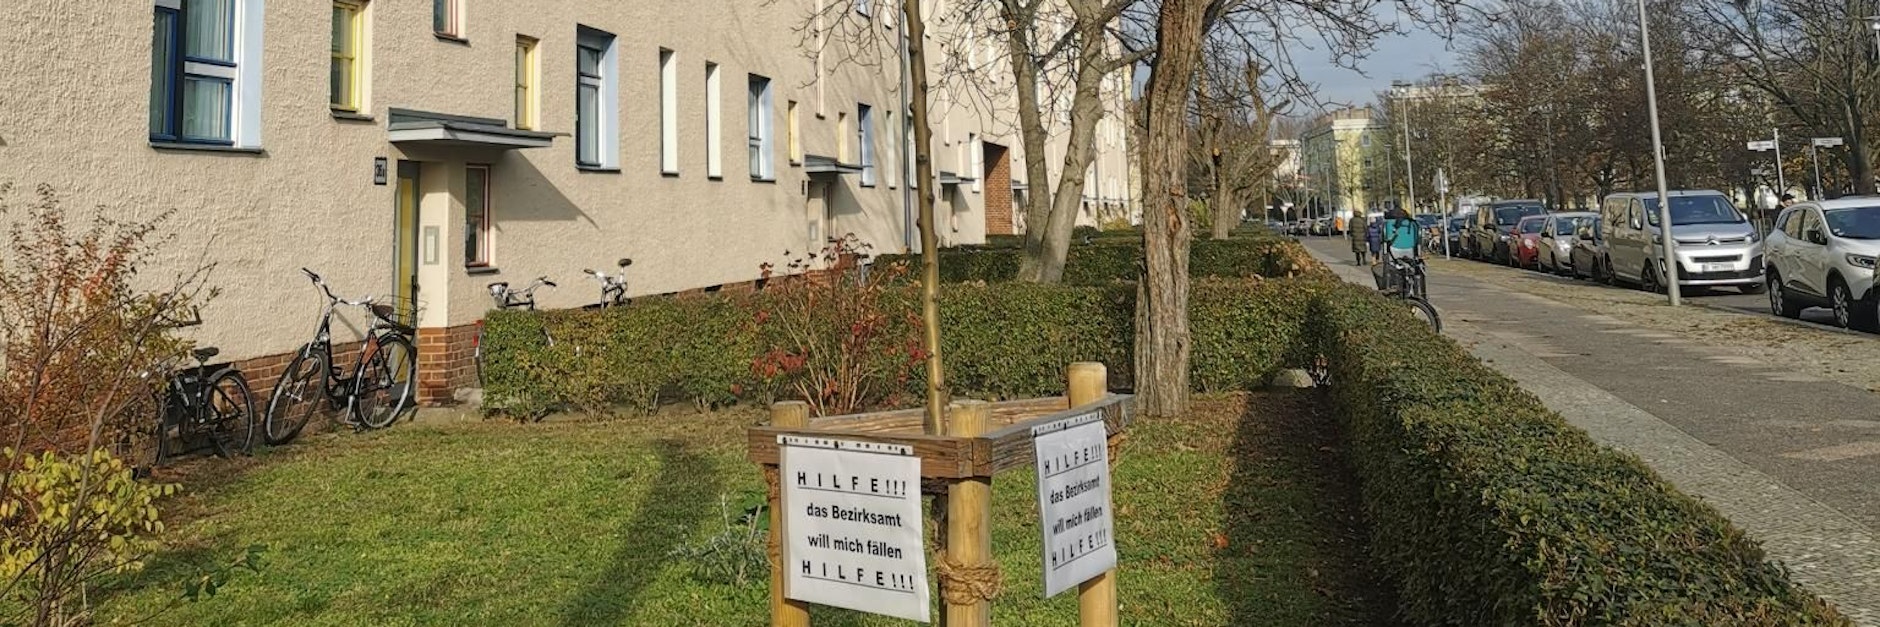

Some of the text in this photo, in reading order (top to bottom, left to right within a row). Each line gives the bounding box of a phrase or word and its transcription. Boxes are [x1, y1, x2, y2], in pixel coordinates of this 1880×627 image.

[1050, 475, 1100, 505] das Bezirksamt
[807, 503, 902, 527] das Bezirksamt
[1052, 506, 1103, 536] will mich fällen
[808, 534, 902, 559] will mich fällen
